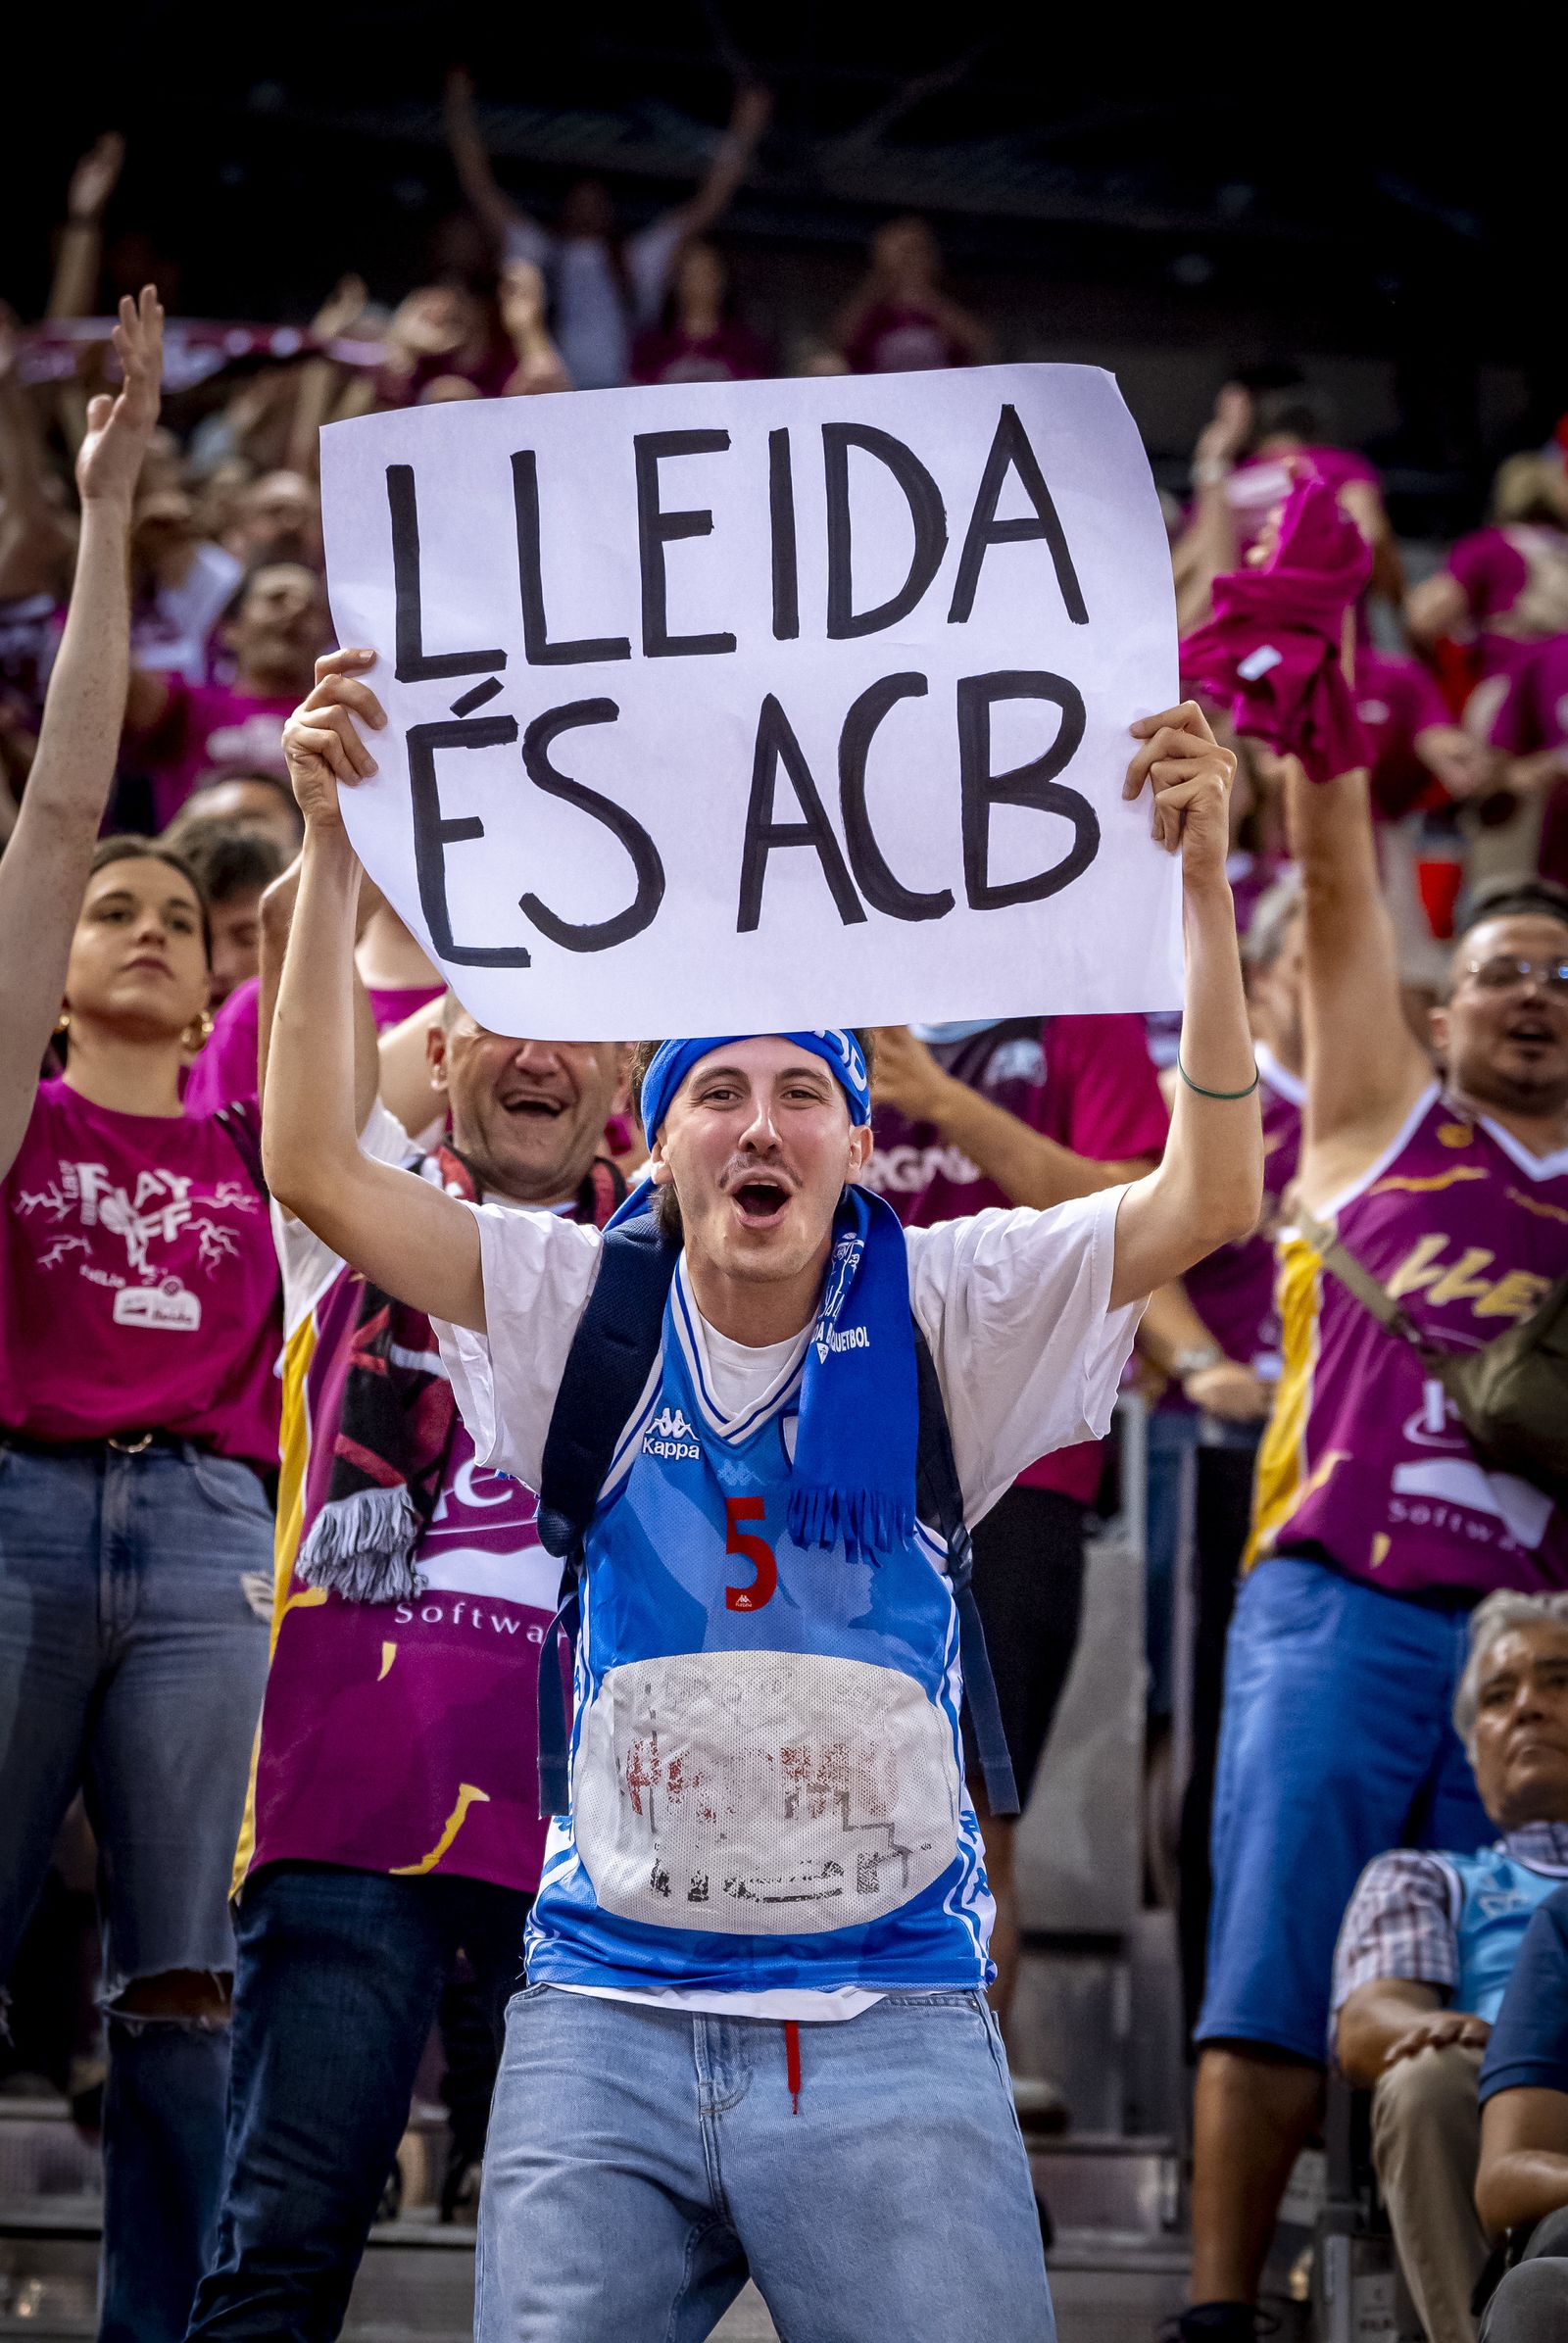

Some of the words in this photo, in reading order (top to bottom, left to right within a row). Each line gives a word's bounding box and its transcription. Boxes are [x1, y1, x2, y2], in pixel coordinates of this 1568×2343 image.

[386, 404, 1089, 682] LLEIDA
[406, 676, 665, 967] ÉS
[737, 670, 1100, 932] ACB
[642, 1438, 700, 1460] Kappa
[725, 1497, 777, 1612] 5
[394, 1601, 568, 1648] Softwar
